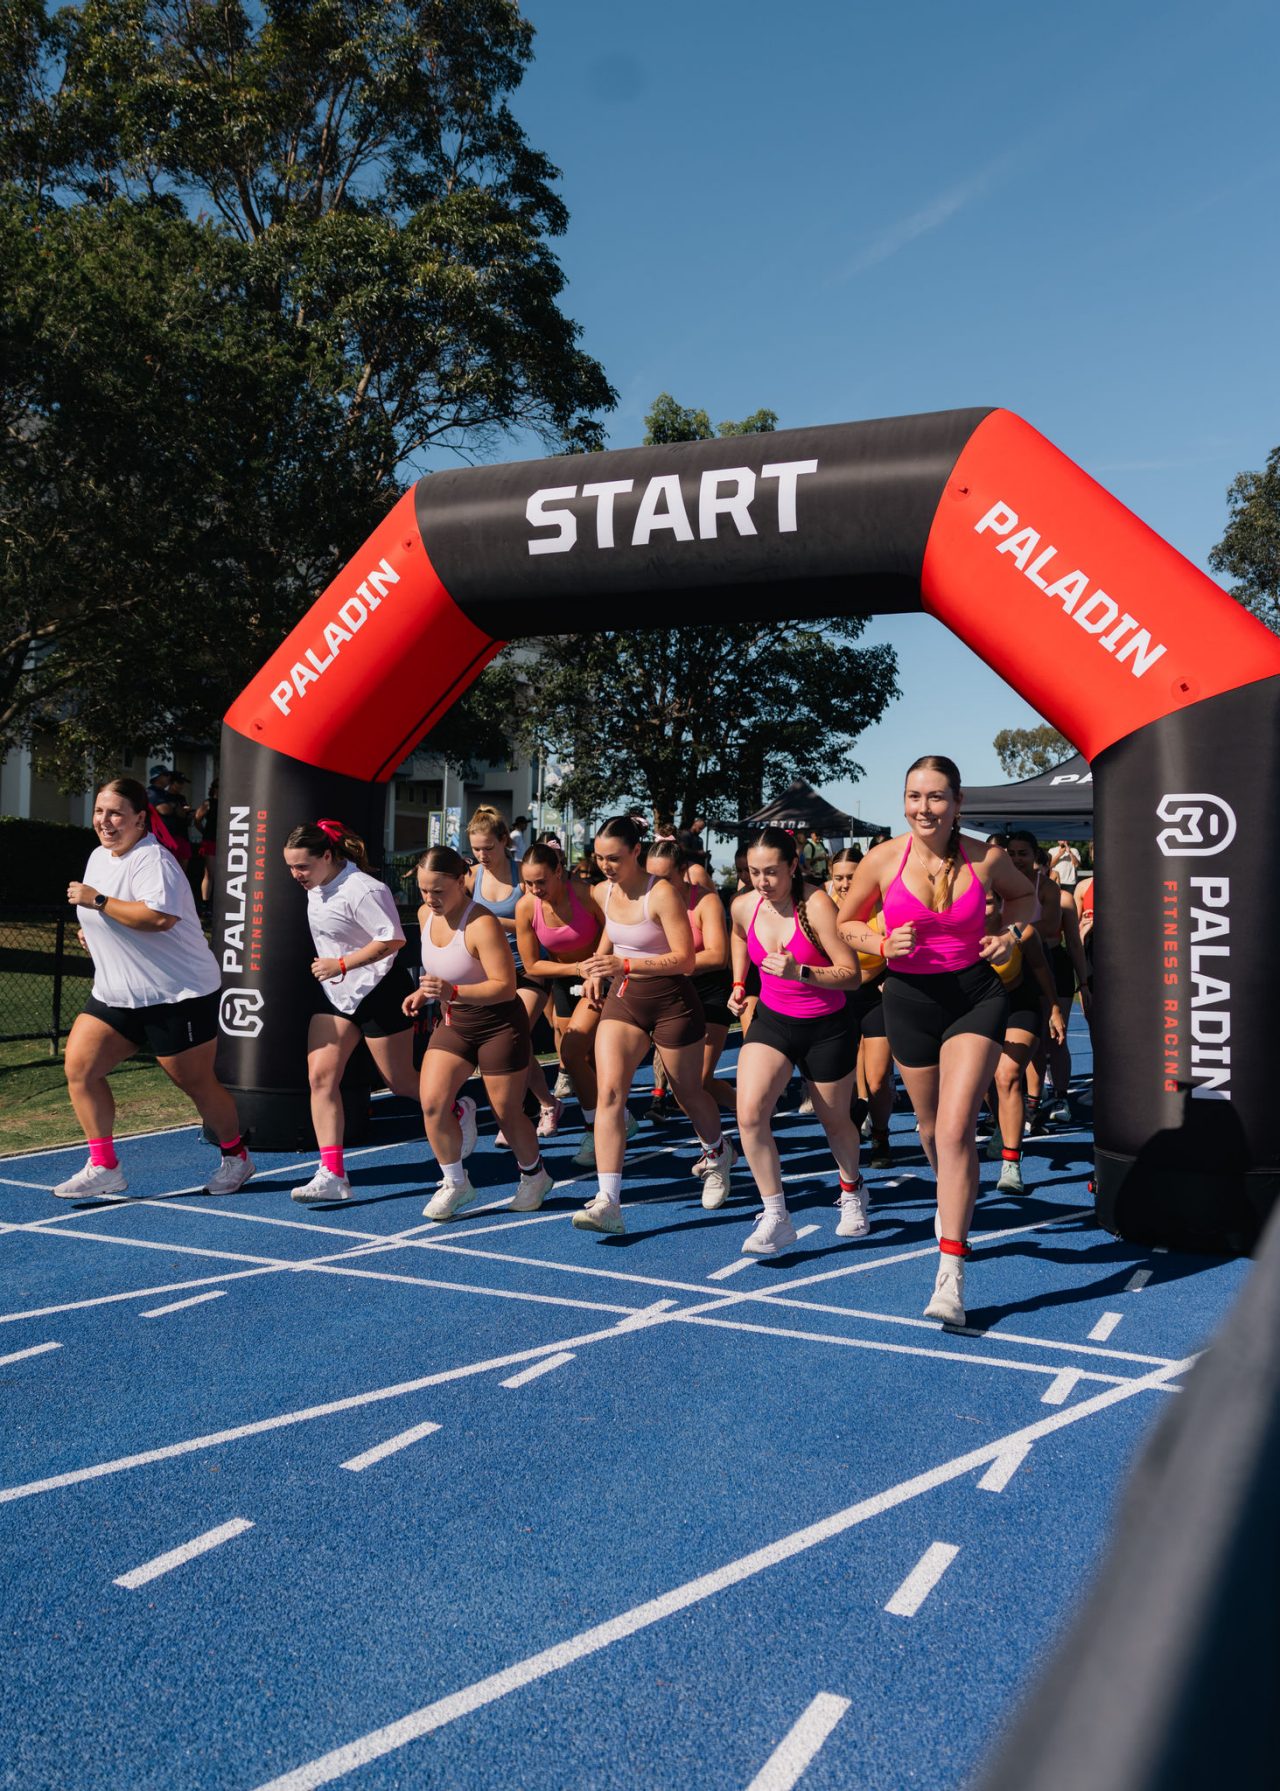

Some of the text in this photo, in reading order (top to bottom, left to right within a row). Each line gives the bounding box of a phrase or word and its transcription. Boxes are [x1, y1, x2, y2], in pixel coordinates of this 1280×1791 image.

[526, 459, 818, 556] START
[974, 500, 1168, 678] PALADIN
[270, 558, 401, 717] PALADIN
[223, 806, 250, 974] PALADIN
[250, 809, 268, 971] FITNESS RACING
[1163, 879, 1180, 1093] FITNESS RACING
[1190, 876, 1231, 1101] PALADIN
